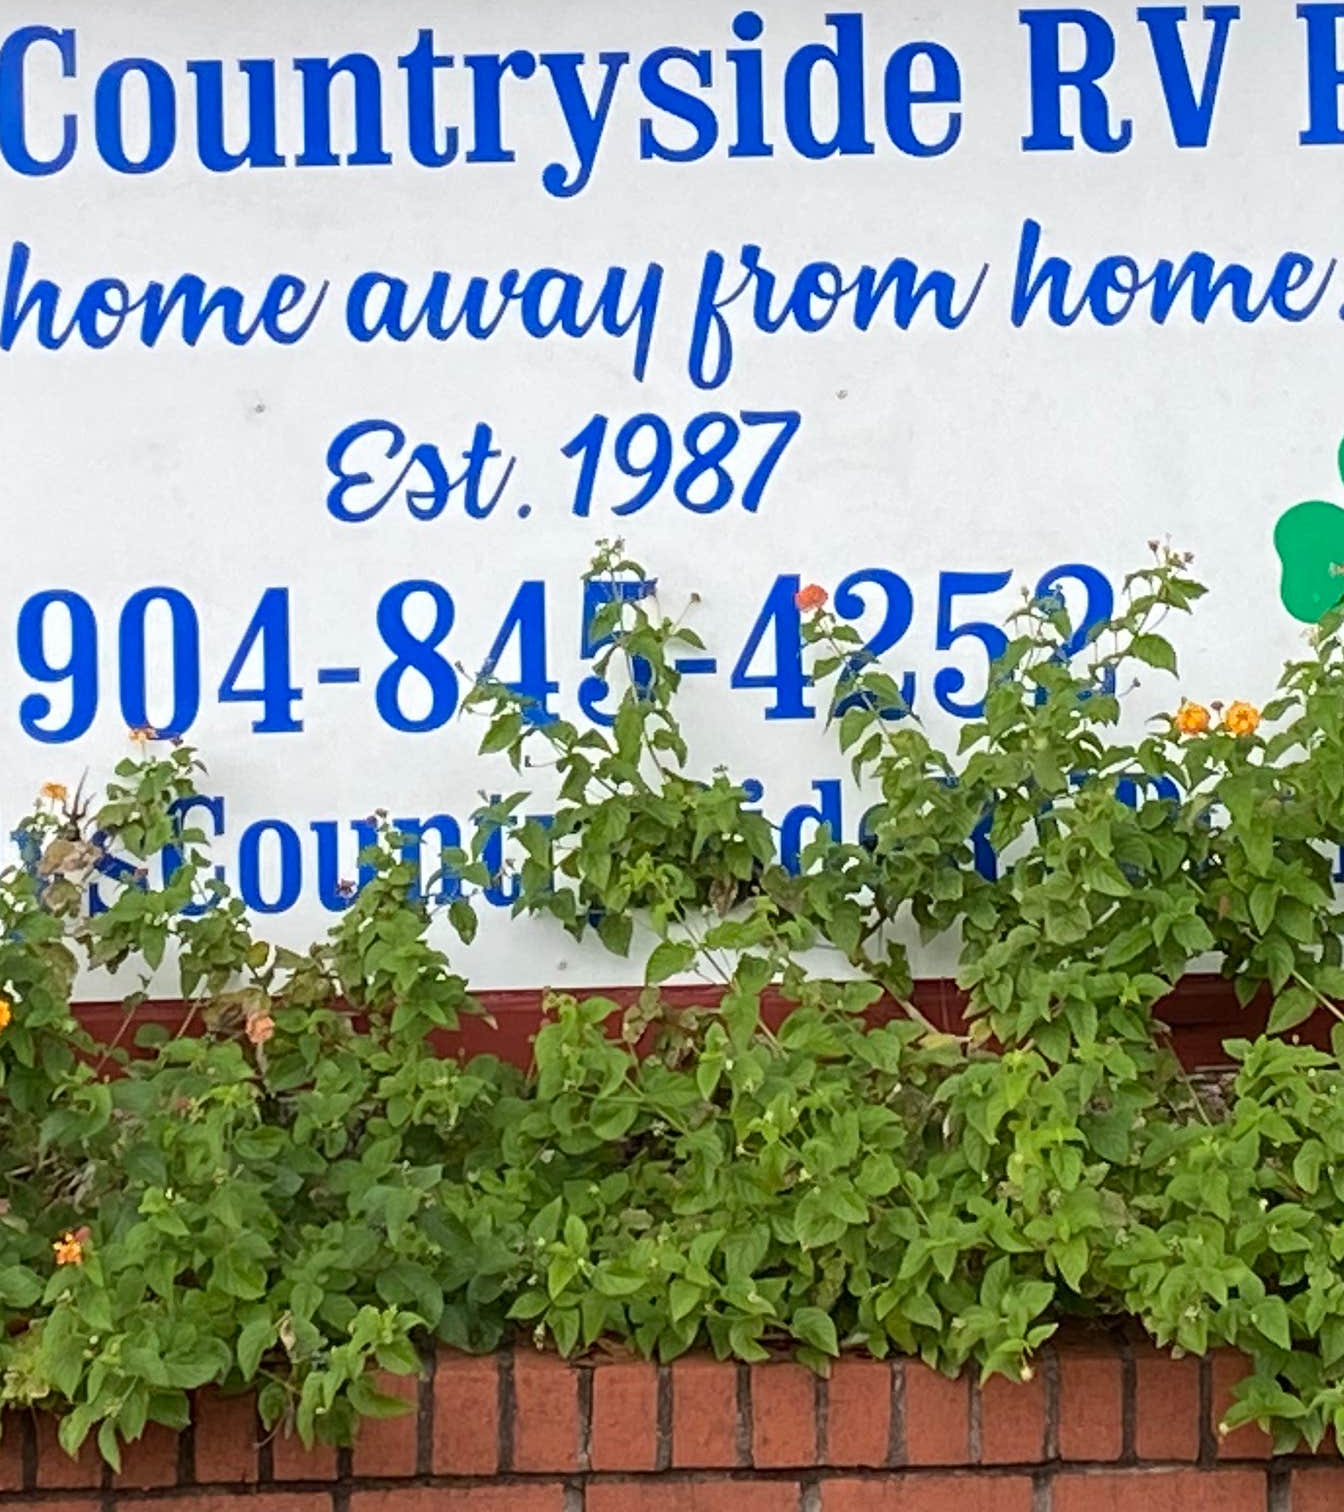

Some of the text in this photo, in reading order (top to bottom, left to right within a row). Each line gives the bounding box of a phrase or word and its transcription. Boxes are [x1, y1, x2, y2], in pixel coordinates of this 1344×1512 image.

[1017, 4, 1242, 154] RV
[344, 262, 664, 383] away
[687, 243, 988, 391] from
[325, 409, 802, 524] Est. 1987
[15, 562, 1117, 745] 904-845-4252
